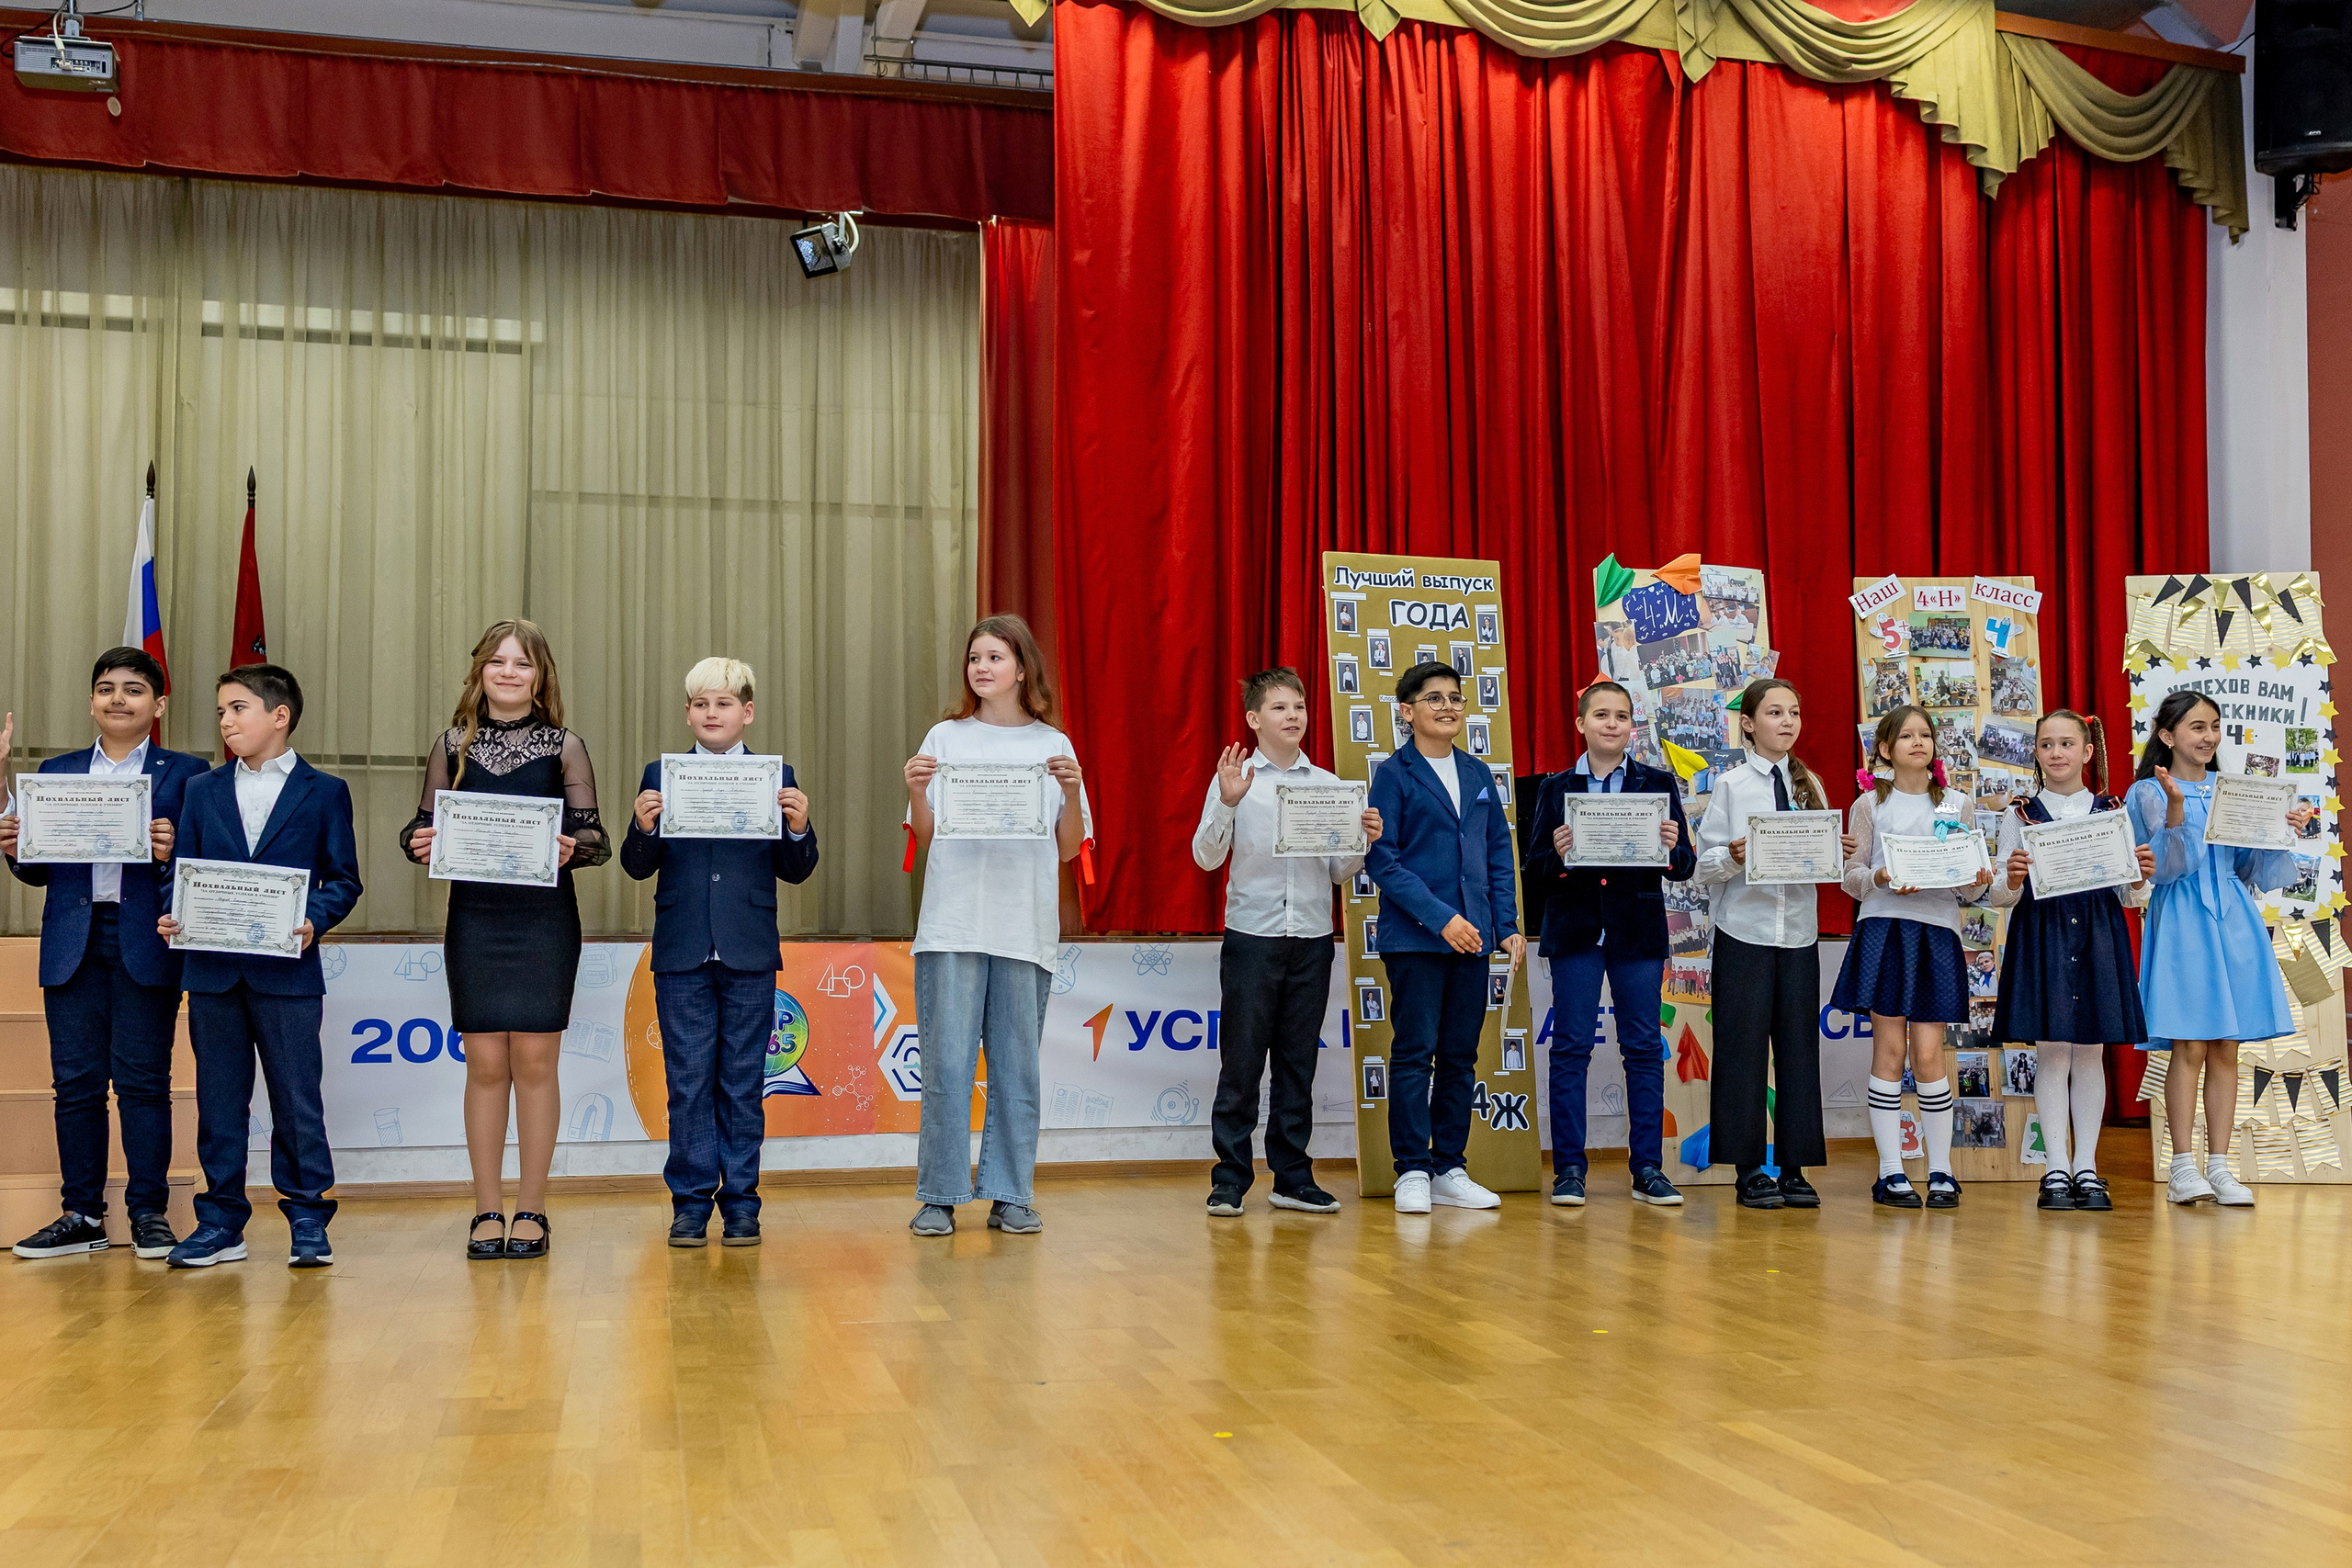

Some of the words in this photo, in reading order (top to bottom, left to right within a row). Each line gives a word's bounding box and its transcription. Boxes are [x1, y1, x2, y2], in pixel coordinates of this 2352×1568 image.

[1335, 567, 1415, 590] Лучший
[1422, 576, 1494, 595] выпуск
[1855, 581, 1899, 613] Наш
[1974, 582, 2034, 608] класс
[1391, 601, 1469, 631] ГОДА
[1986, 617, 2010, 649] 4
[2257, 682, 2294, 703] ВАМ
[1472, 1082, 1529, 1129] 4Ж
